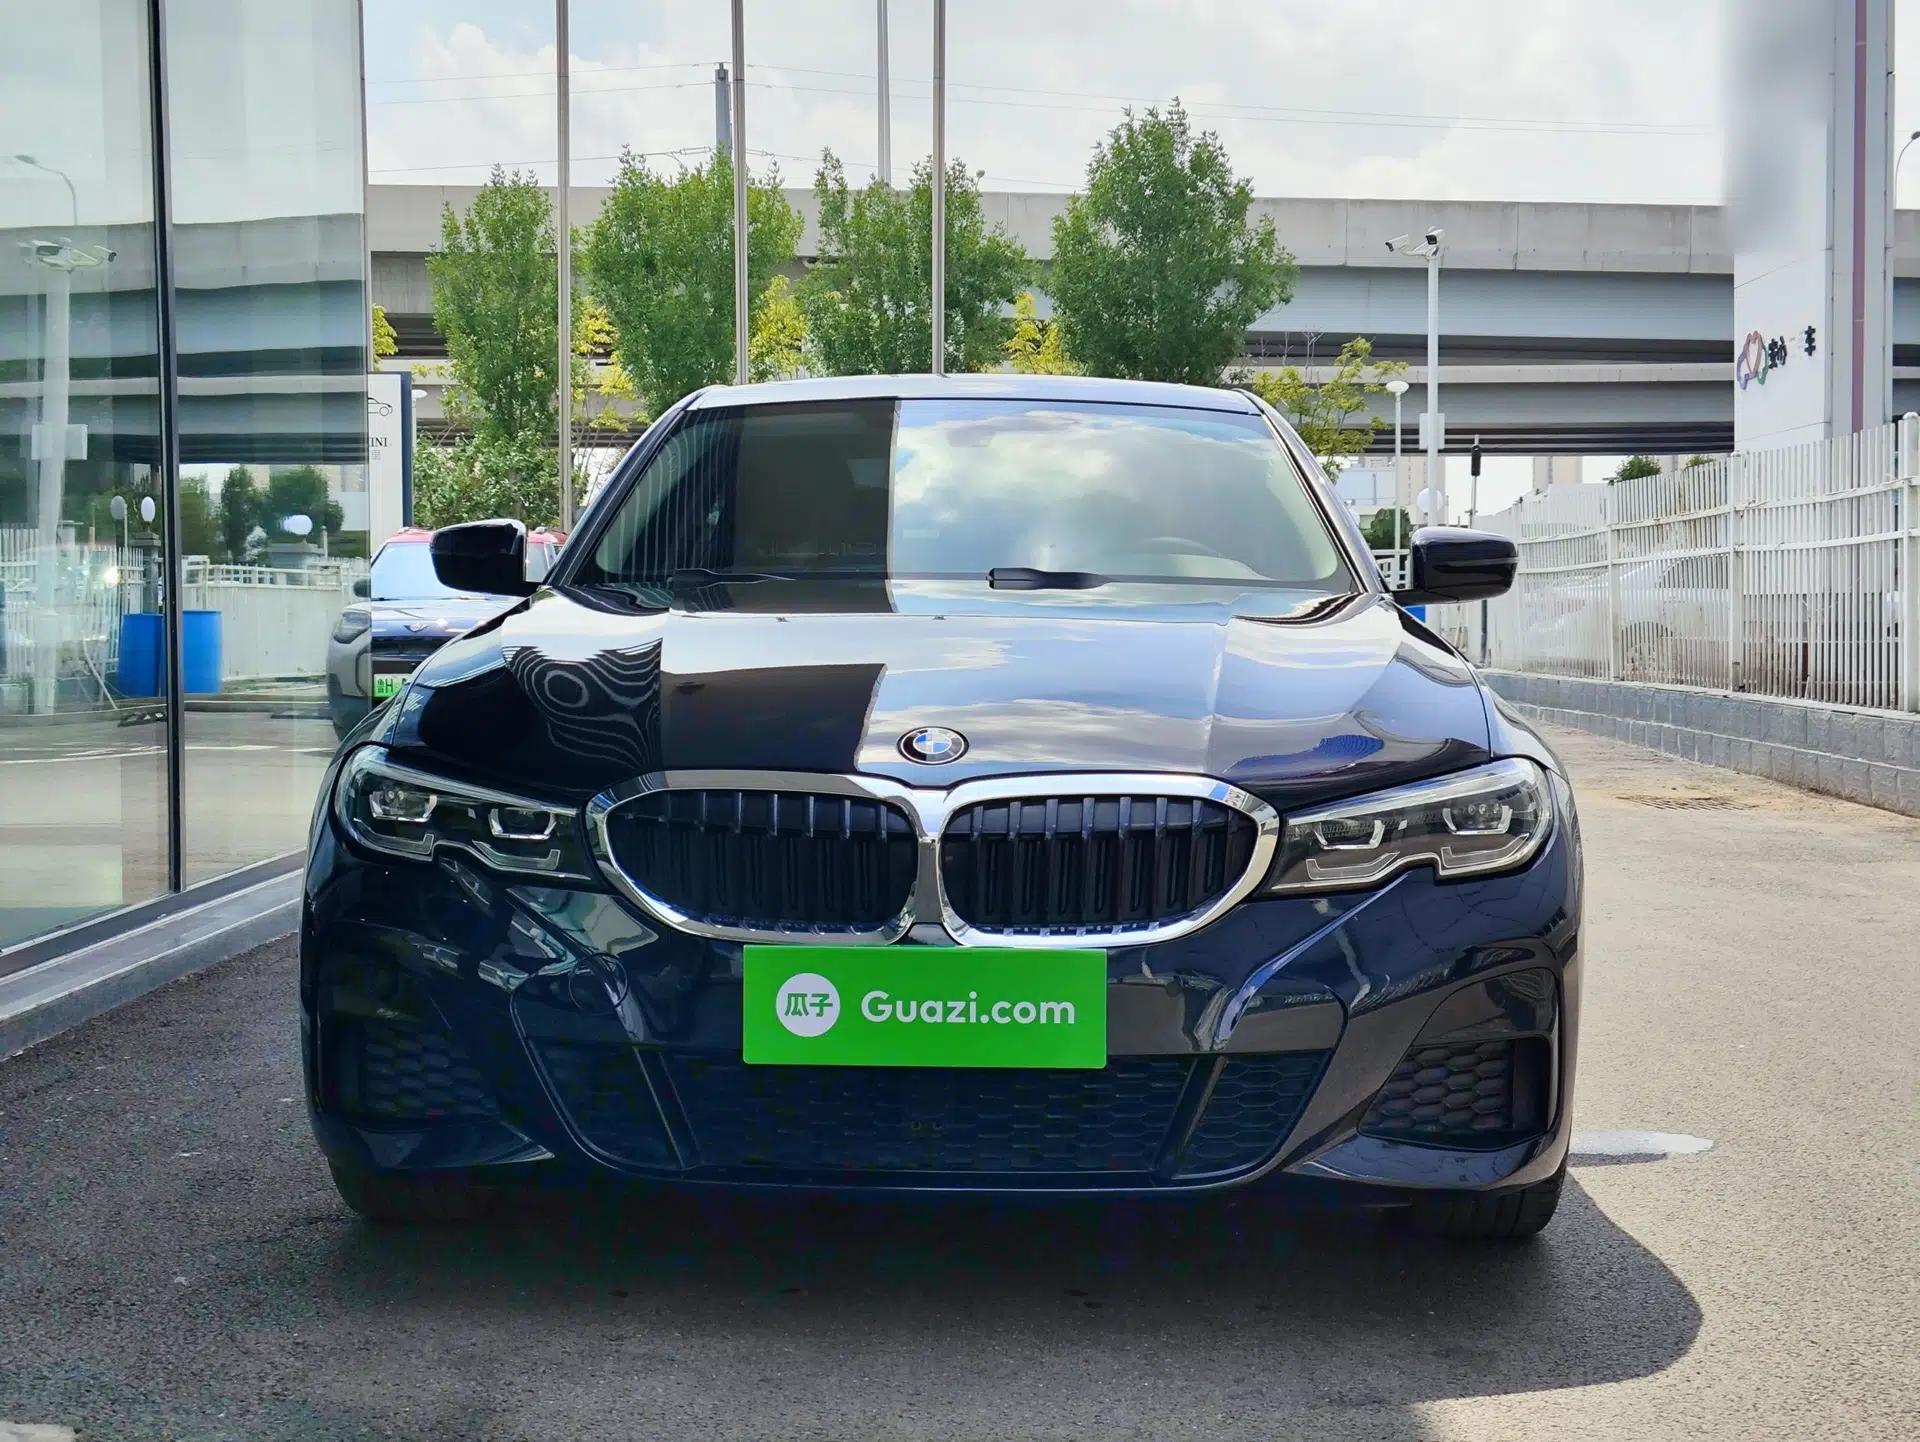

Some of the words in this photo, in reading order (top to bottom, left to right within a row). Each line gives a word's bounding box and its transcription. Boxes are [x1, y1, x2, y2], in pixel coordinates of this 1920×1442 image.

[368, 436, 389, 447] INI
[784, 993, 833, 1018] 瓜子
[861, 990, 1076, 1025] Guazi.com
